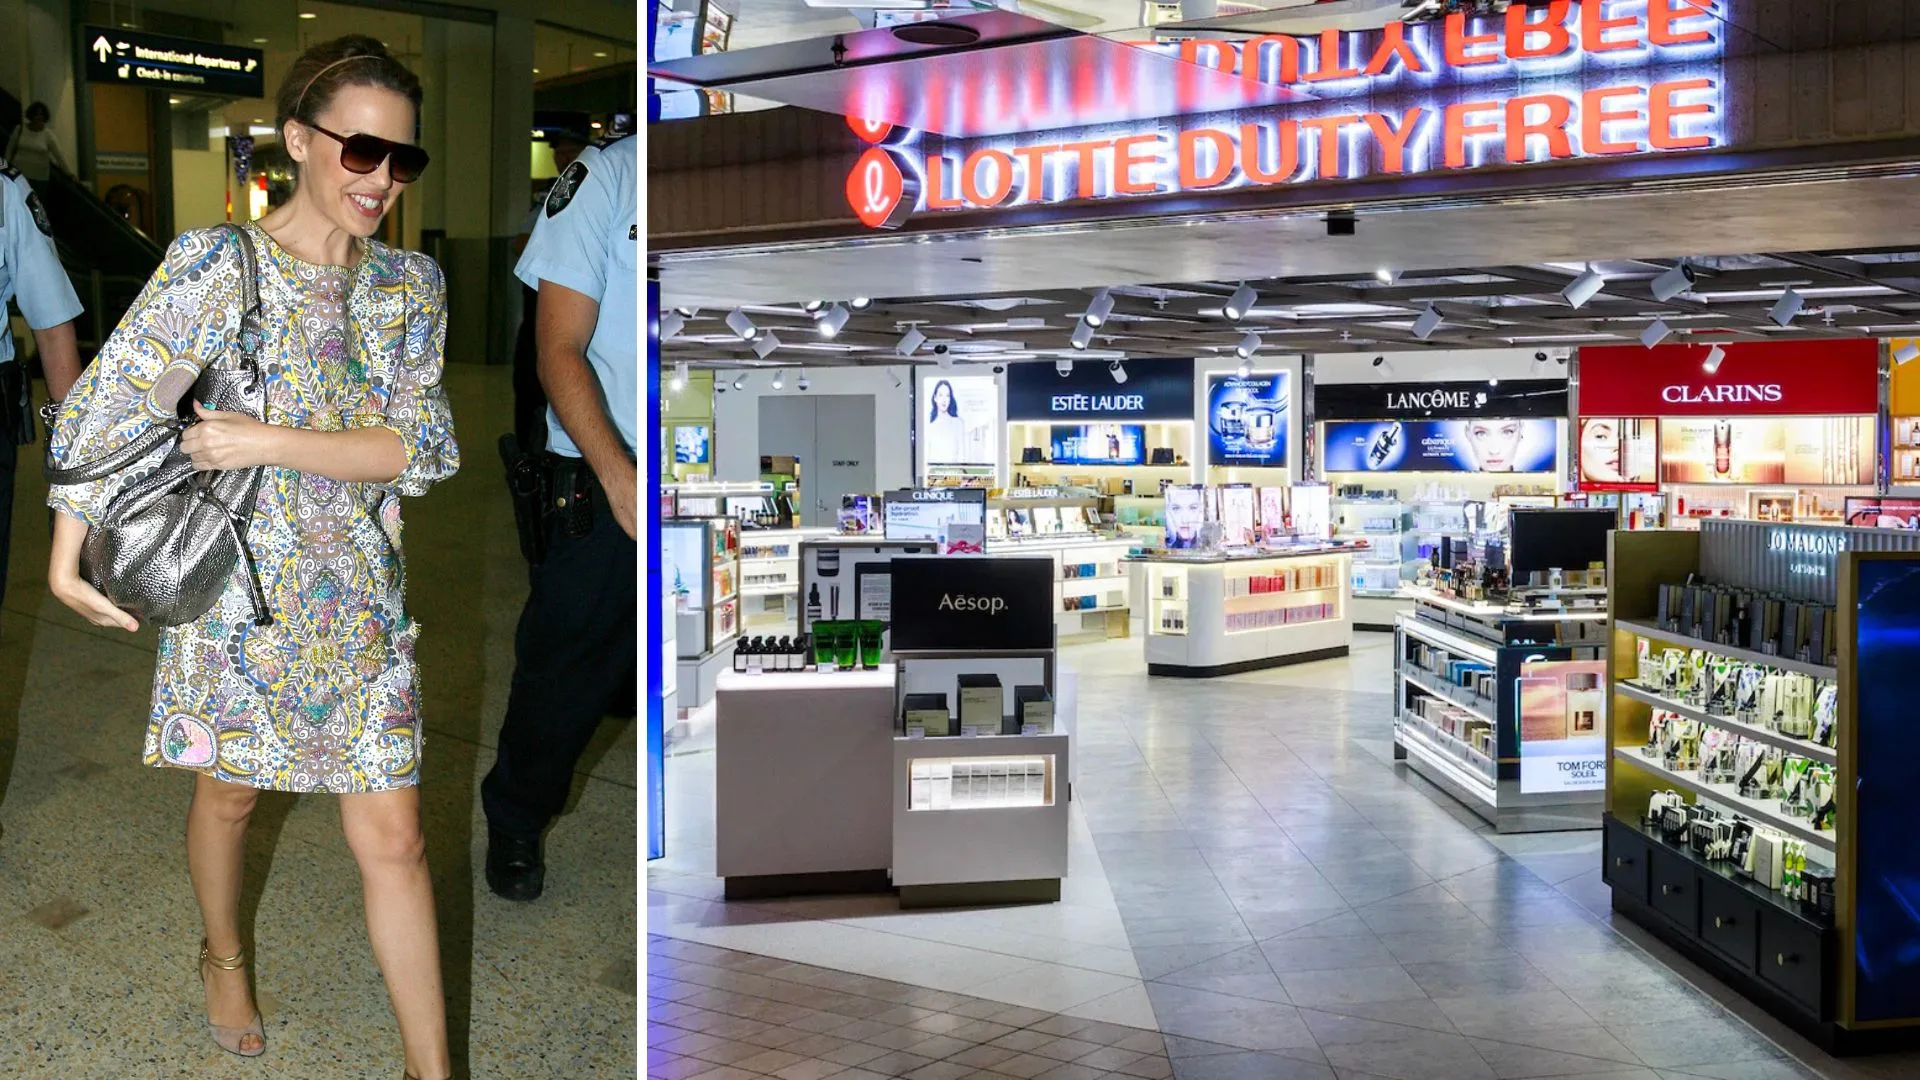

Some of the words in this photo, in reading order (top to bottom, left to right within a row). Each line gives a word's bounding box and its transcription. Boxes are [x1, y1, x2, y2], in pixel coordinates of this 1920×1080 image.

[135, 46, 194, 64] International
[195, 53, 241, 71] departures
[136, 67, 171, 81] Check-in
[172, 73, 205, 85] counters
[926, 133, 1160, 210] LOTTE
[1178, 105, 1423, 188] DUTY
[1444, 78, 1711, 169] FREE
[1387, 389, 1470, 409] LANCÔME
[1661, 384, 1783, 403] CLARINS
[1091, 395, 1145, 411] LAUDER
[912, 491, 954, 500] CLINIQUE
[1556, 761, 1581, 771] TOM
[1571, 770, 1597, 778] SOLEIL
